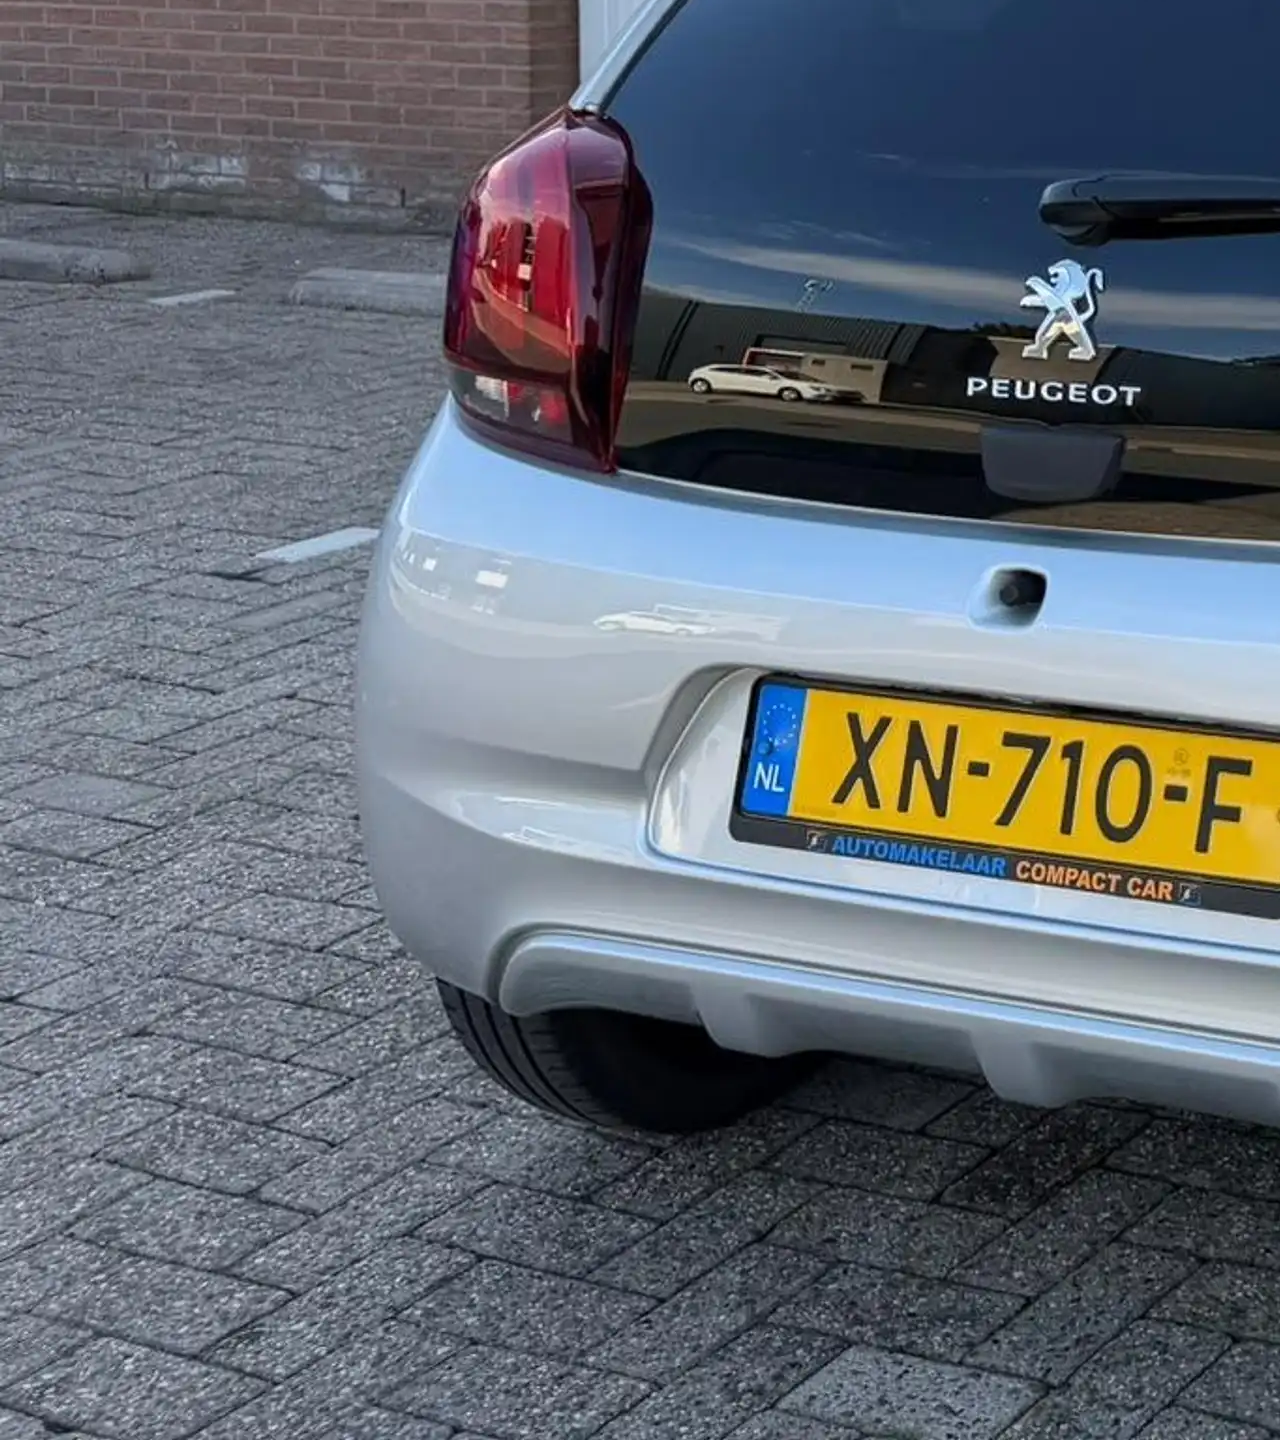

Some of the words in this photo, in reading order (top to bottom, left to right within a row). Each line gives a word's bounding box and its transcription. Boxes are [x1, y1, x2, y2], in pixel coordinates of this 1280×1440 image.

[966, 377, 1141, 407] PEUGEOT
[753, 761, 784, 793] NL
[831, 712, 1252, 853] XN-710-F
[832, 835, 1006, 878] AUTOMAKELAAR
[1016, 859, 1121, 893] COMPACT
[1126, 876, 1174, 902] CAR
